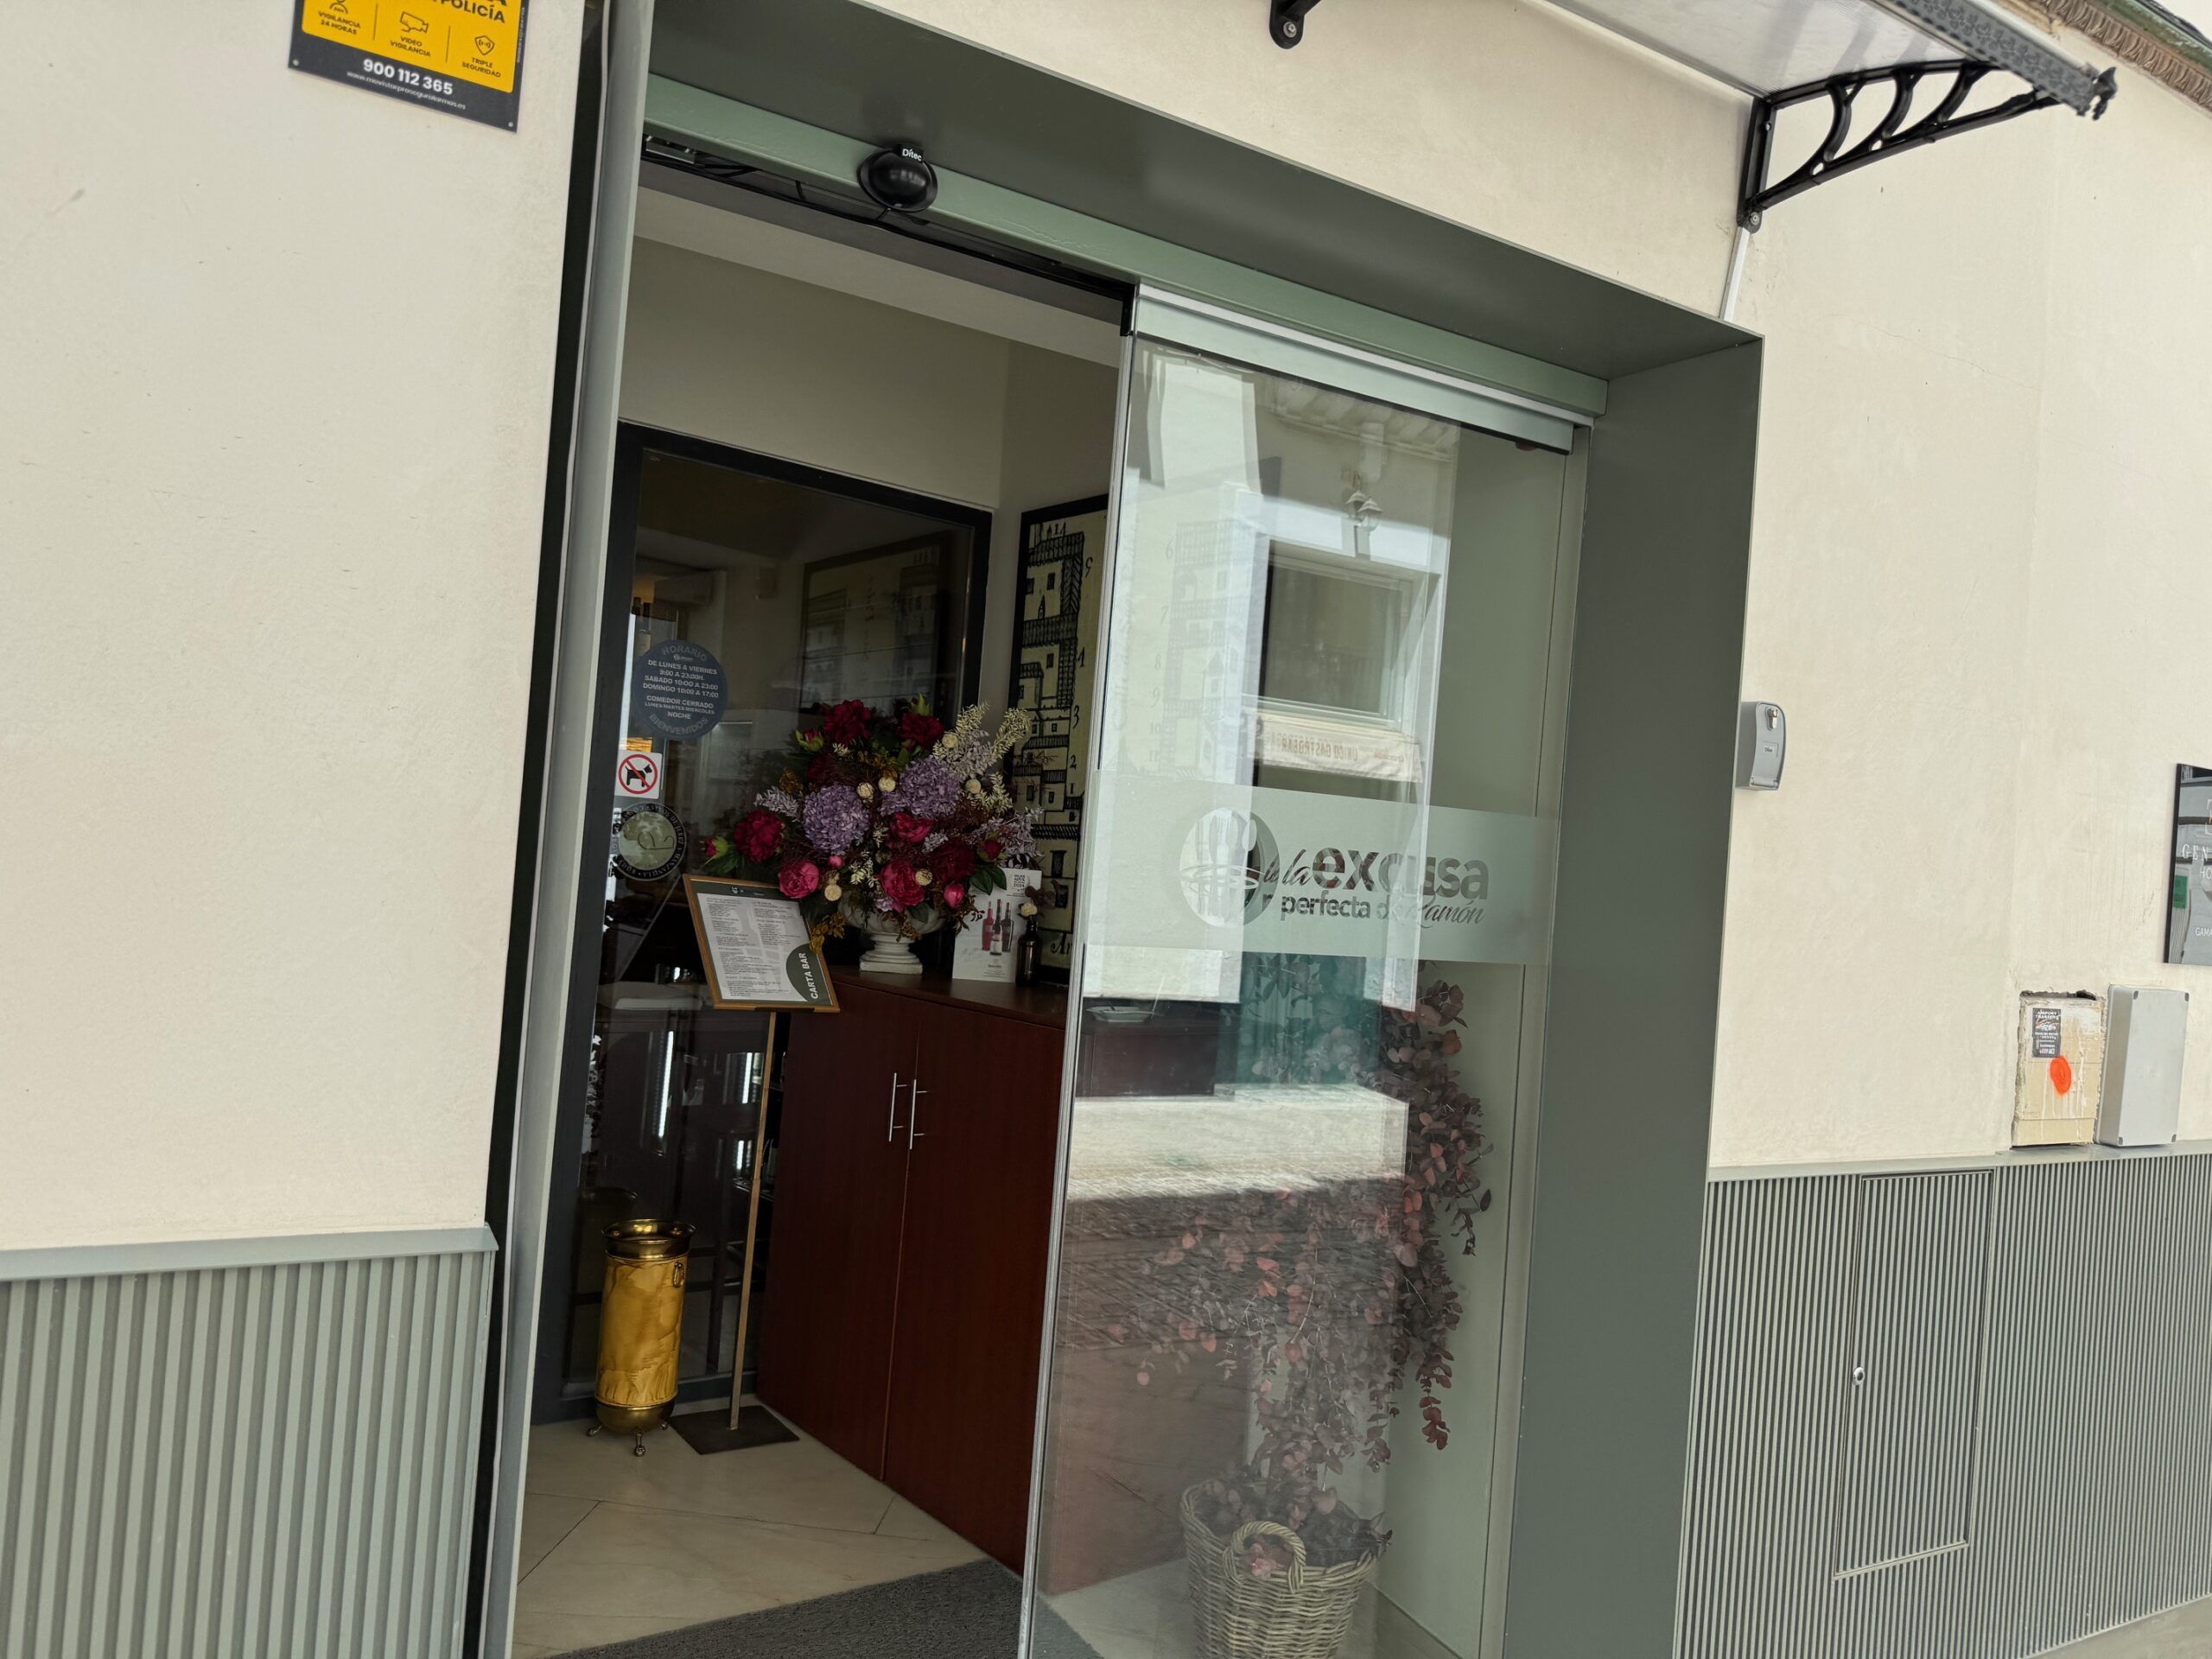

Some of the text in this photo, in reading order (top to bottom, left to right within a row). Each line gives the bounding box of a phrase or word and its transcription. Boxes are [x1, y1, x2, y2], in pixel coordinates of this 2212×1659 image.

[318, 11, 361, 29] VIGILANCIA
[331, 22, 357, 35] HORAS
[390, 40, 431, 57] VIGILANCIA
[400, 35, 423, 47] VIDEO
[461, 61, 501, 79] SEGURIDAD
[472, 57, 493, 68] TRIPLE
[363, 58, 454, 95] 900 112 365
[663, 645, 707, 661] HORARIO
[658, 662, 682, 671] LUNES
[689, 665, 718, 675] VIERNES
[643, 683, 676, 692] DOMINGO
[645, 675, 673, 684] SABADO
[646, 695, 714, 709] COMEDOR CERRADO
[649, 714, 709, 734] BIENVENIDOS
[1072, 705, 1080, 729] 3
[1071, 754, 1077, 770] 2
[1281, 847, 1489, 900] la excusa
[1281, 890, 1371, 921] perfecta
[1407, 895, 1485, 929] Ramón
[798, 952, 819, 1000] CARTA BAR
